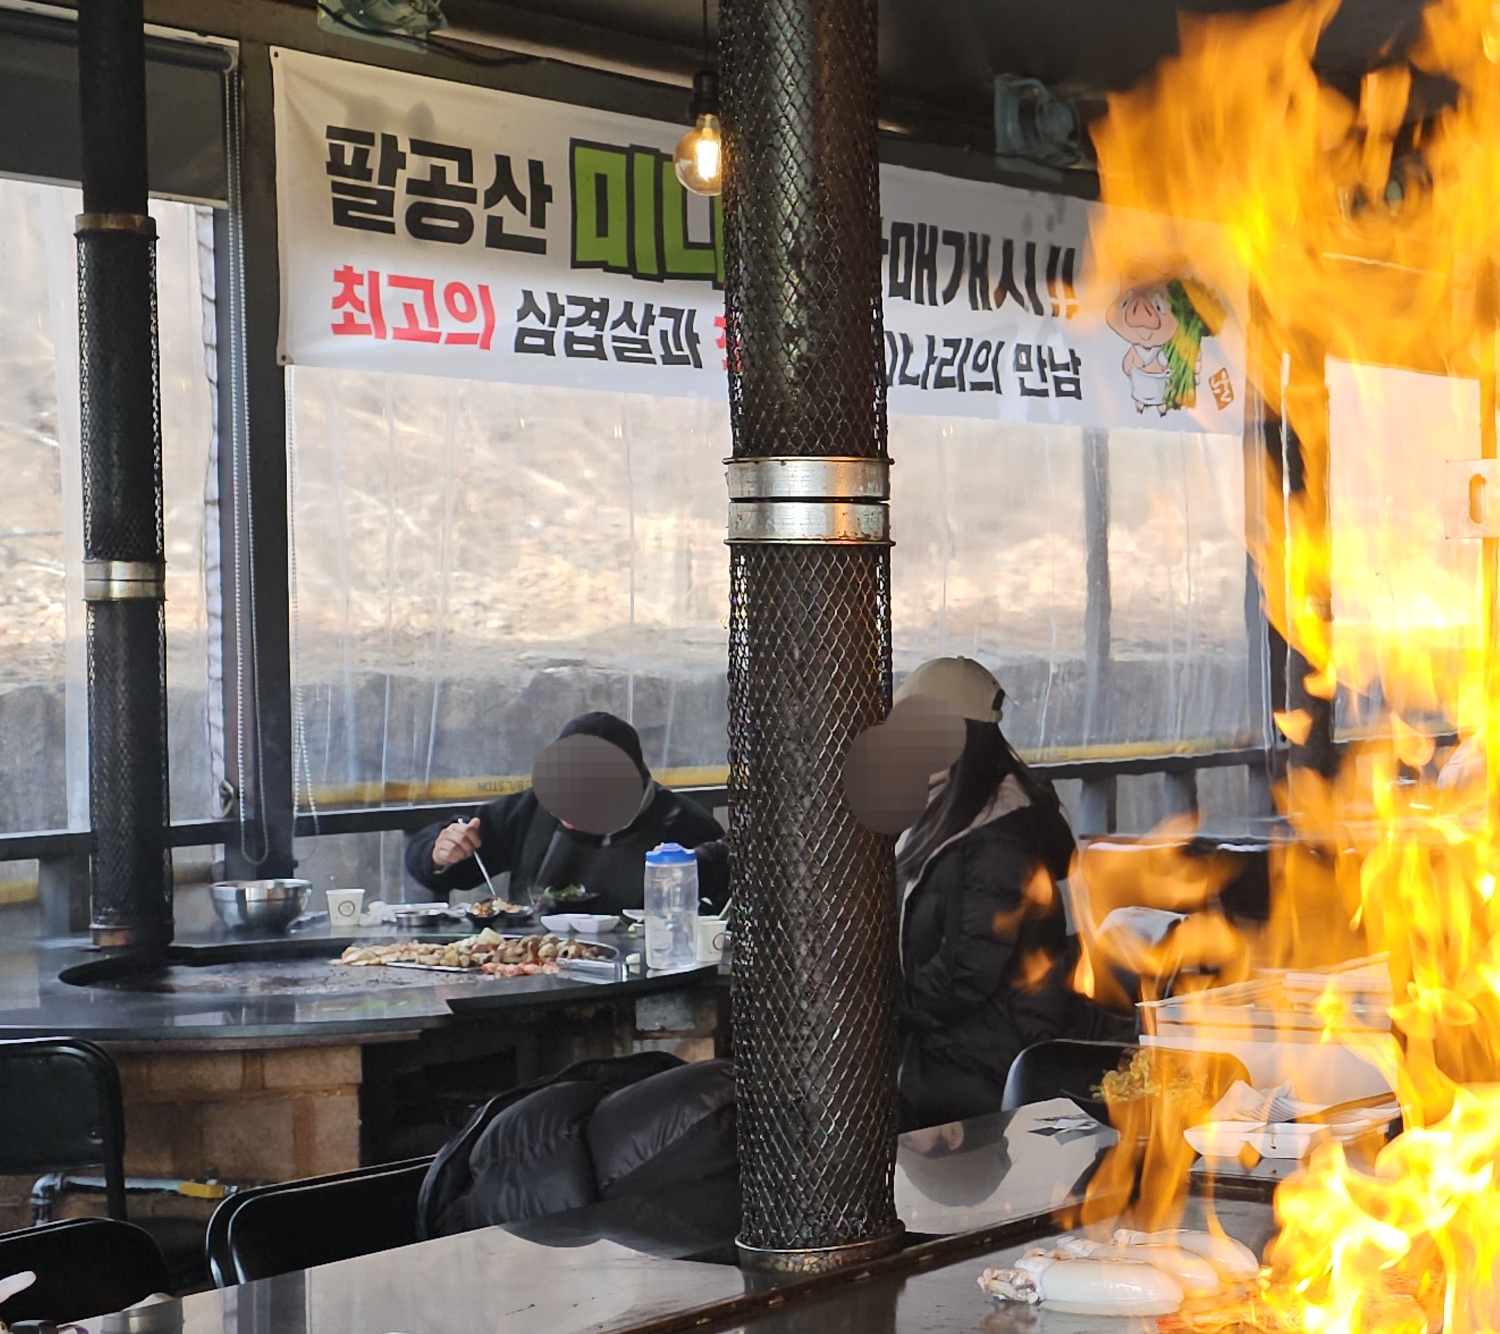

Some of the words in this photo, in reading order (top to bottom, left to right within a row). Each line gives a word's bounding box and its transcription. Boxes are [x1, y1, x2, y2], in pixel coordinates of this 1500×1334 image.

[326, 125, 553, 255] 팔공산
[570, 137, 725, 290] 미나
[880, 218, 1081, 320] 매개시!!
[331, 265, 496, 351] 최고의
[514, 289, 703, 369] 삼겹살과
[1013, 343, 1082, 401] 만남
